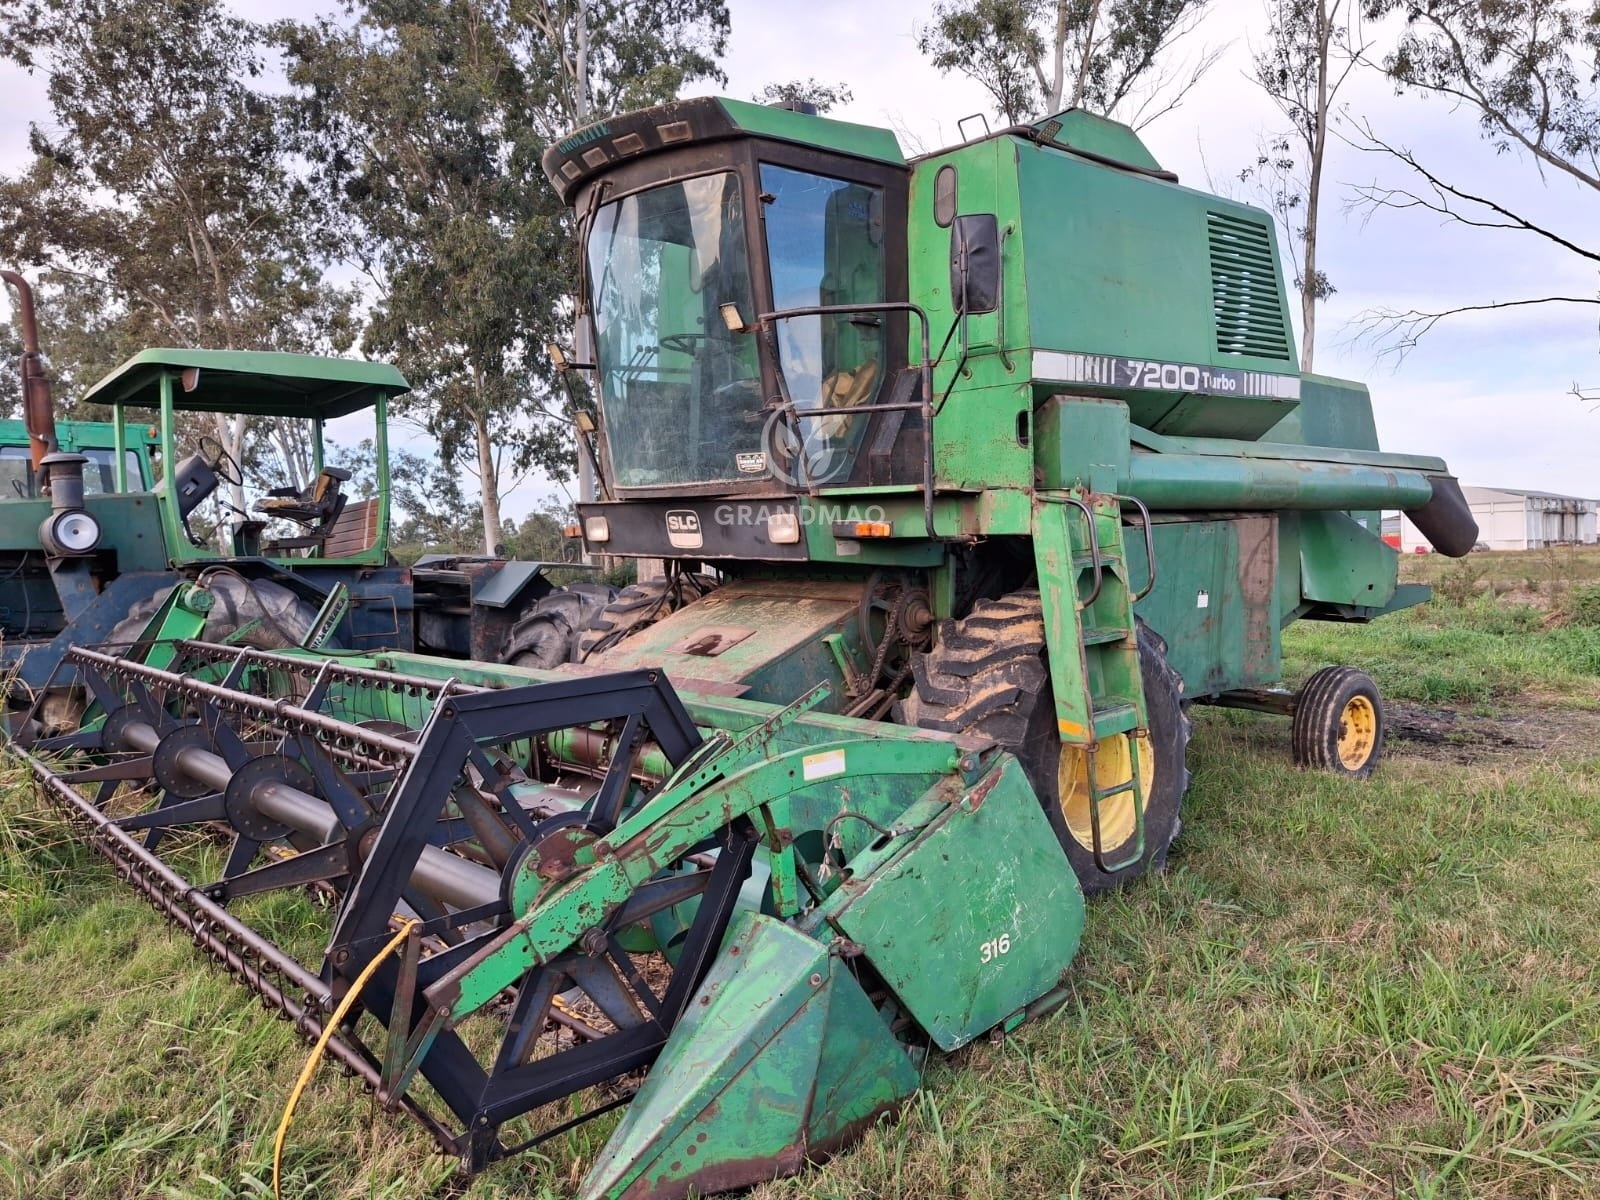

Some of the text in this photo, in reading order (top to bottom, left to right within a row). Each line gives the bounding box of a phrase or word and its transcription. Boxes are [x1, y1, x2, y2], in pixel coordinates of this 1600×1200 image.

[1128, 360, 1236, 391] 7200 Turbo
[668, 515, 698, 530] SLC
[980, 933, 1010, 964] 316
